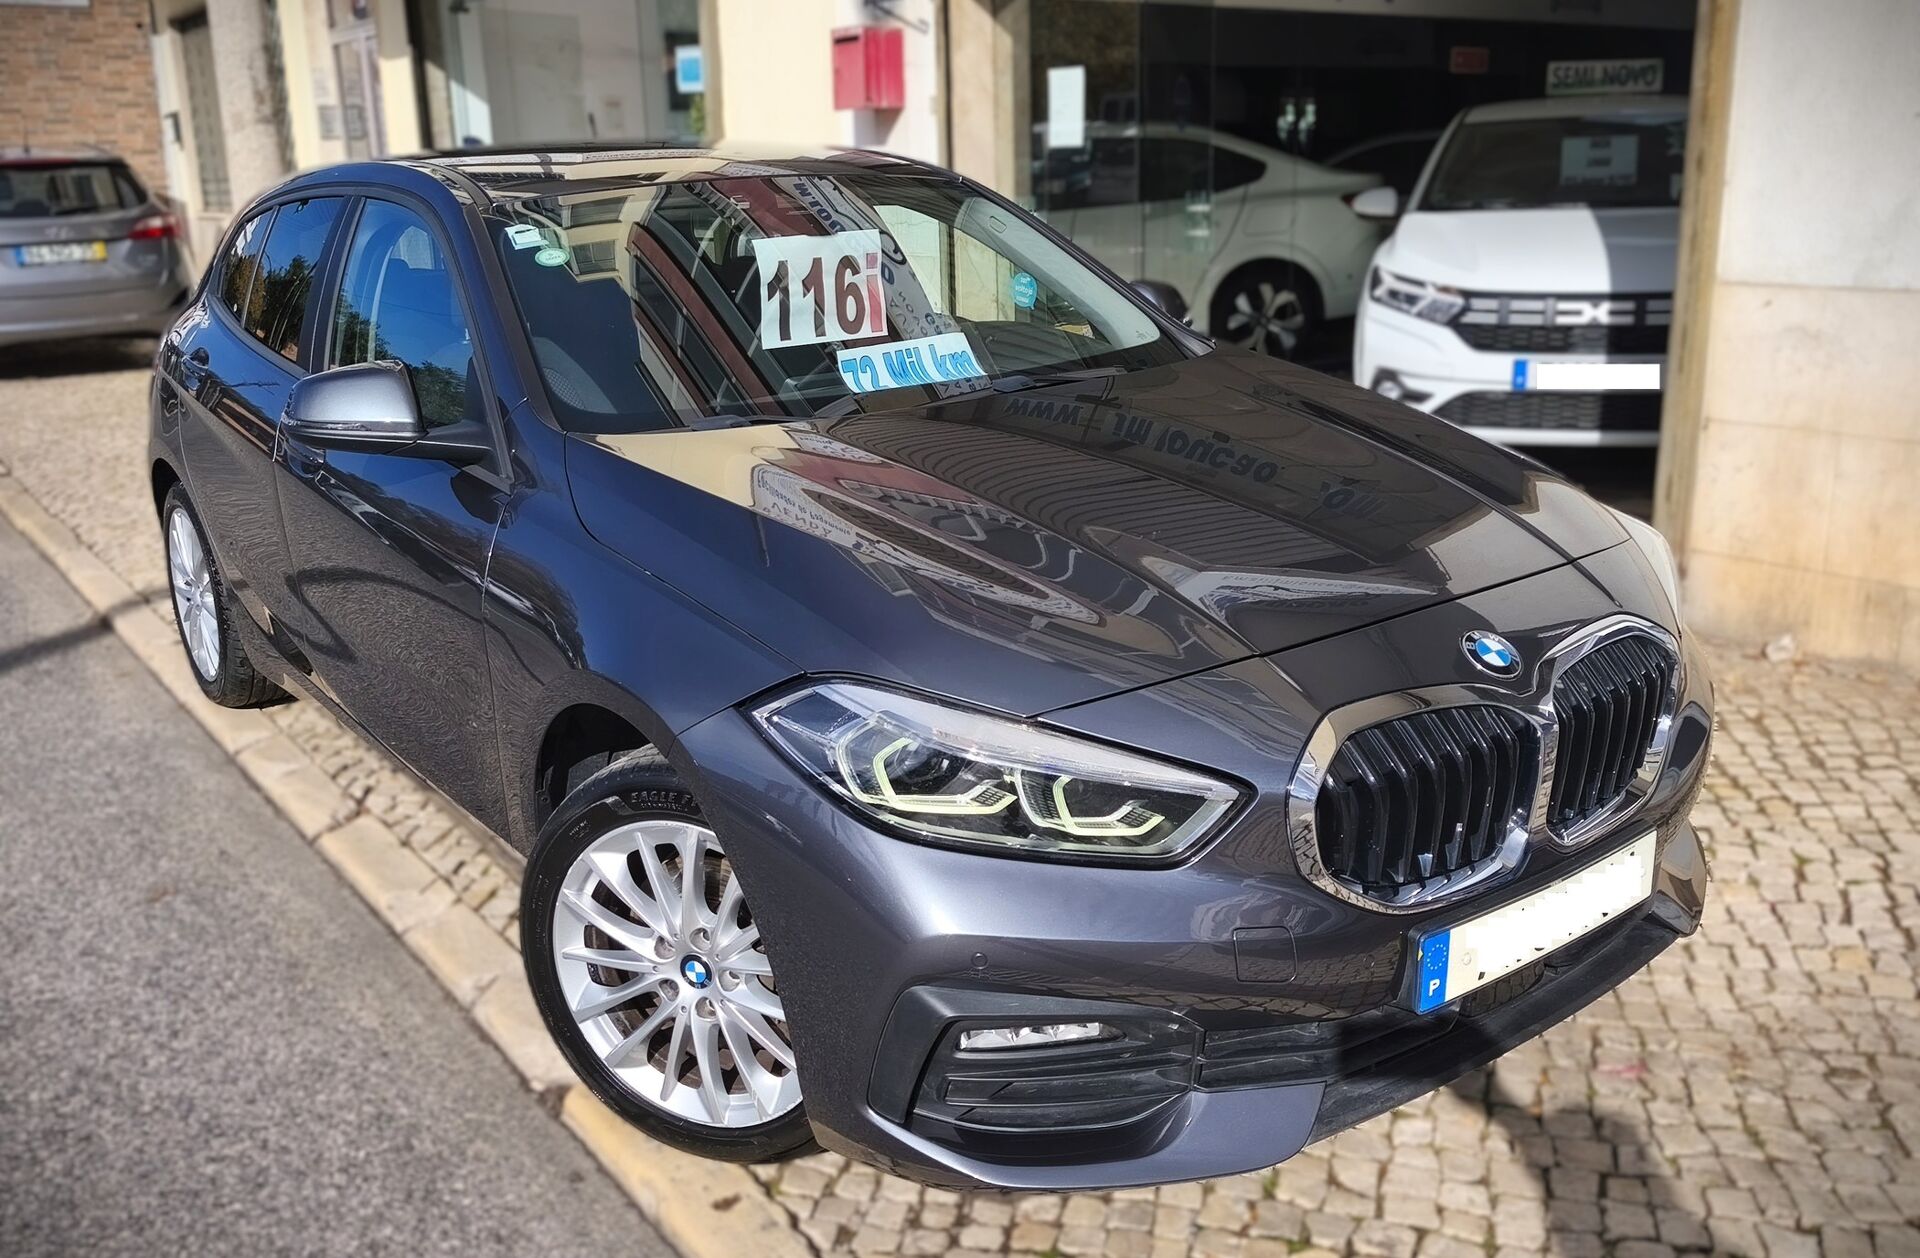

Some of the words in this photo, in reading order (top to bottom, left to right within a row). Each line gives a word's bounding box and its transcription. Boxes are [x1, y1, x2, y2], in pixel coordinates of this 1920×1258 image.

[767, 252, 884, 342] 116i
[840, 355, 888, 393] 72
[882, 346, 932, 387] Mil
[928, 343, 984, 380] km
[631, 790, 678, 803] EAGLE
[1428, 978, 1441, 997] P
